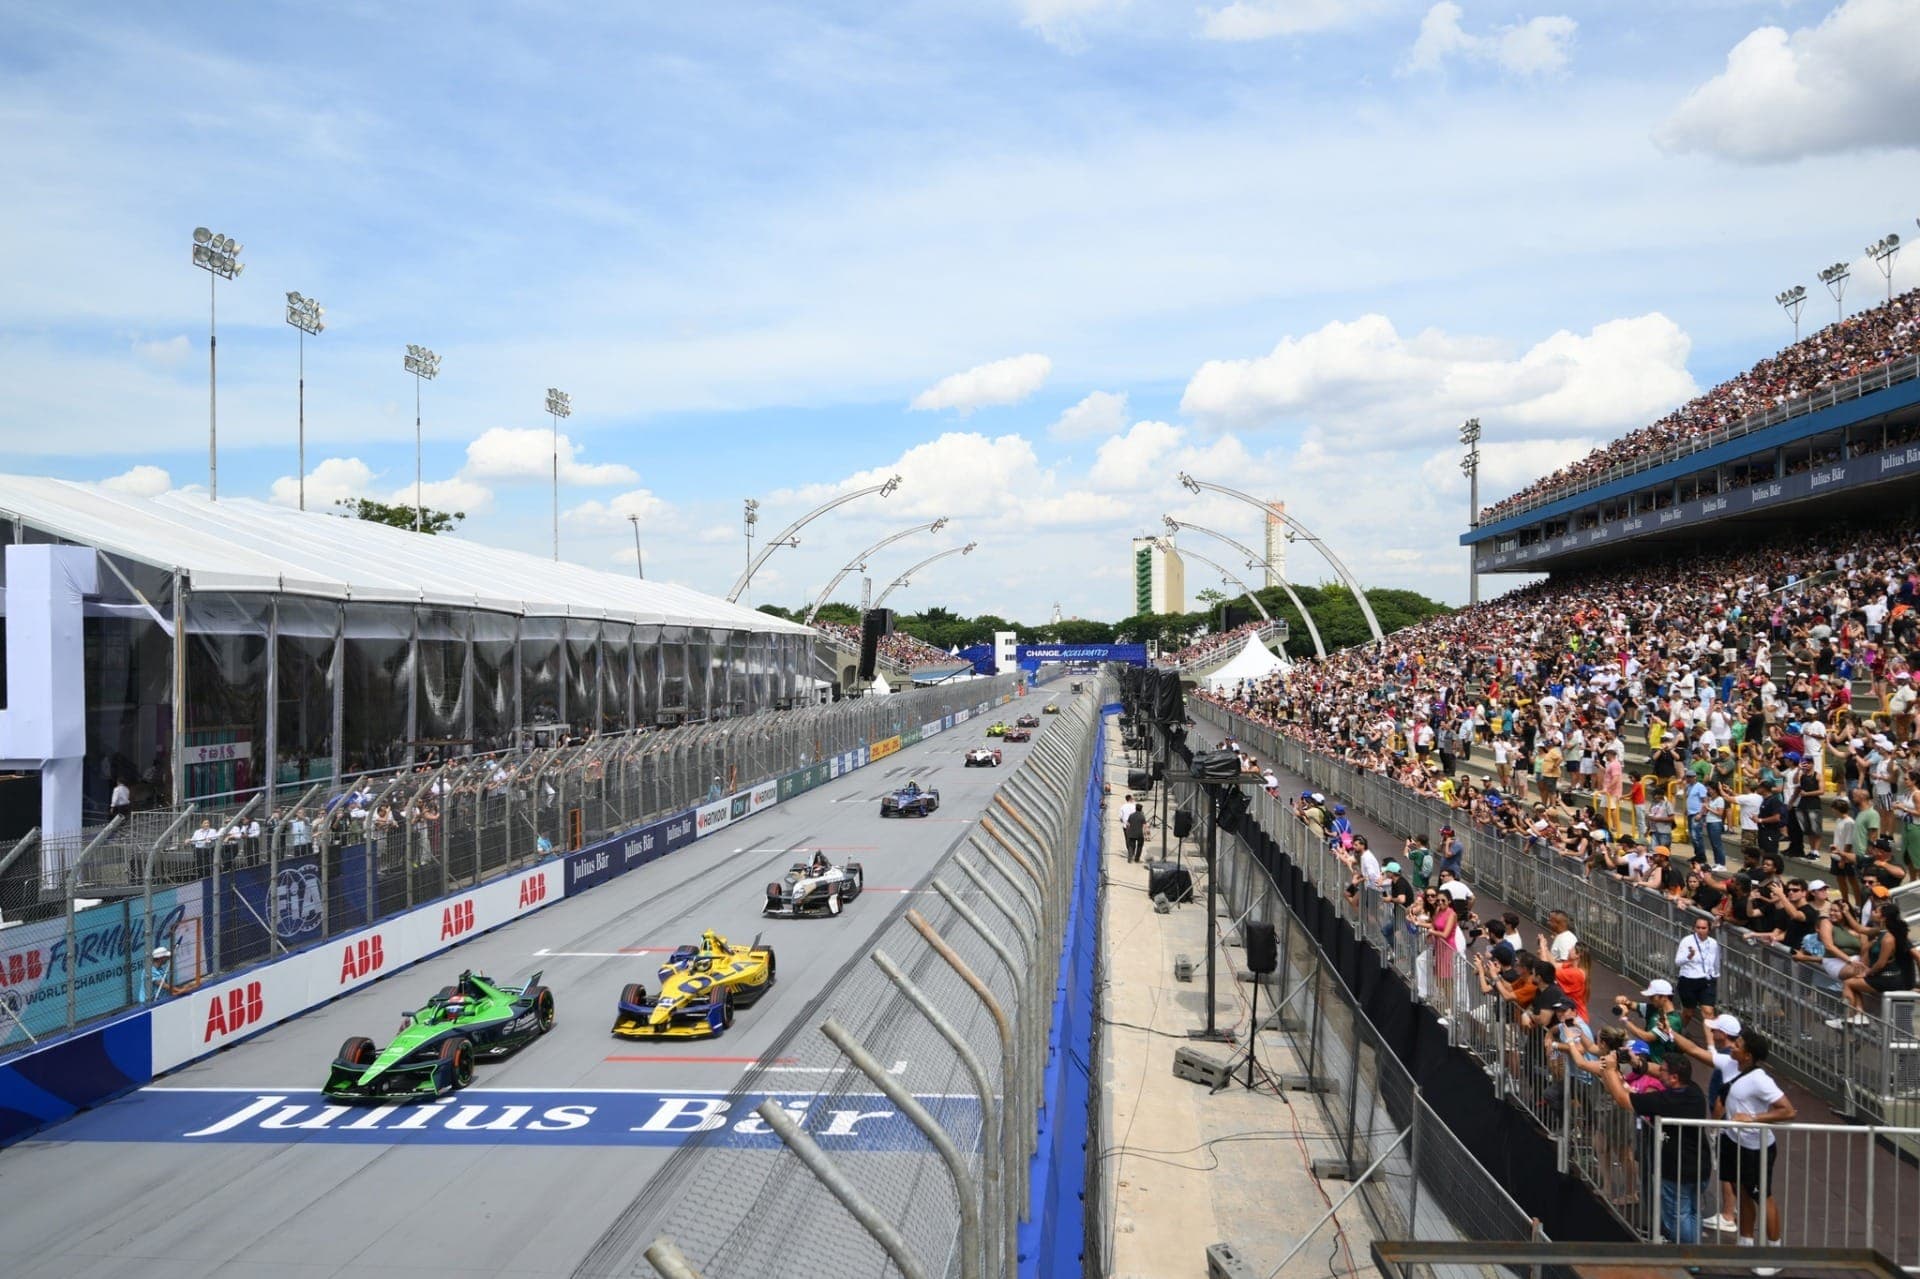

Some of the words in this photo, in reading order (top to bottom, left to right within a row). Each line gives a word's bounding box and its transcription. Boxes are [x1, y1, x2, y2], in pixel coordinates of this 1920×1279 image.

[1811, 472, 1831, 489] Julius
[1831, 467, 1846, 481] Bär
[1881, 454, 1905, 472] Julius
[624, 840, 643, 863] Julius
[643, 834, 655, 851] Bär
[666, 824, 682, 845] Julius
[573, 859, 596, 884] Julius
[596, 852, 610, 871] Bär
[519, 872, 546, 908] ABB
[441, 899, 475, 940] ABB
[340, 935, 384, 983] ABB
[25, 984, 68, 1005] WORLD
[204, 981, 264, 1043] ABB
[183, 1095, 598, 1137] Julius
[629, 1097, 895, 1136] Bär
